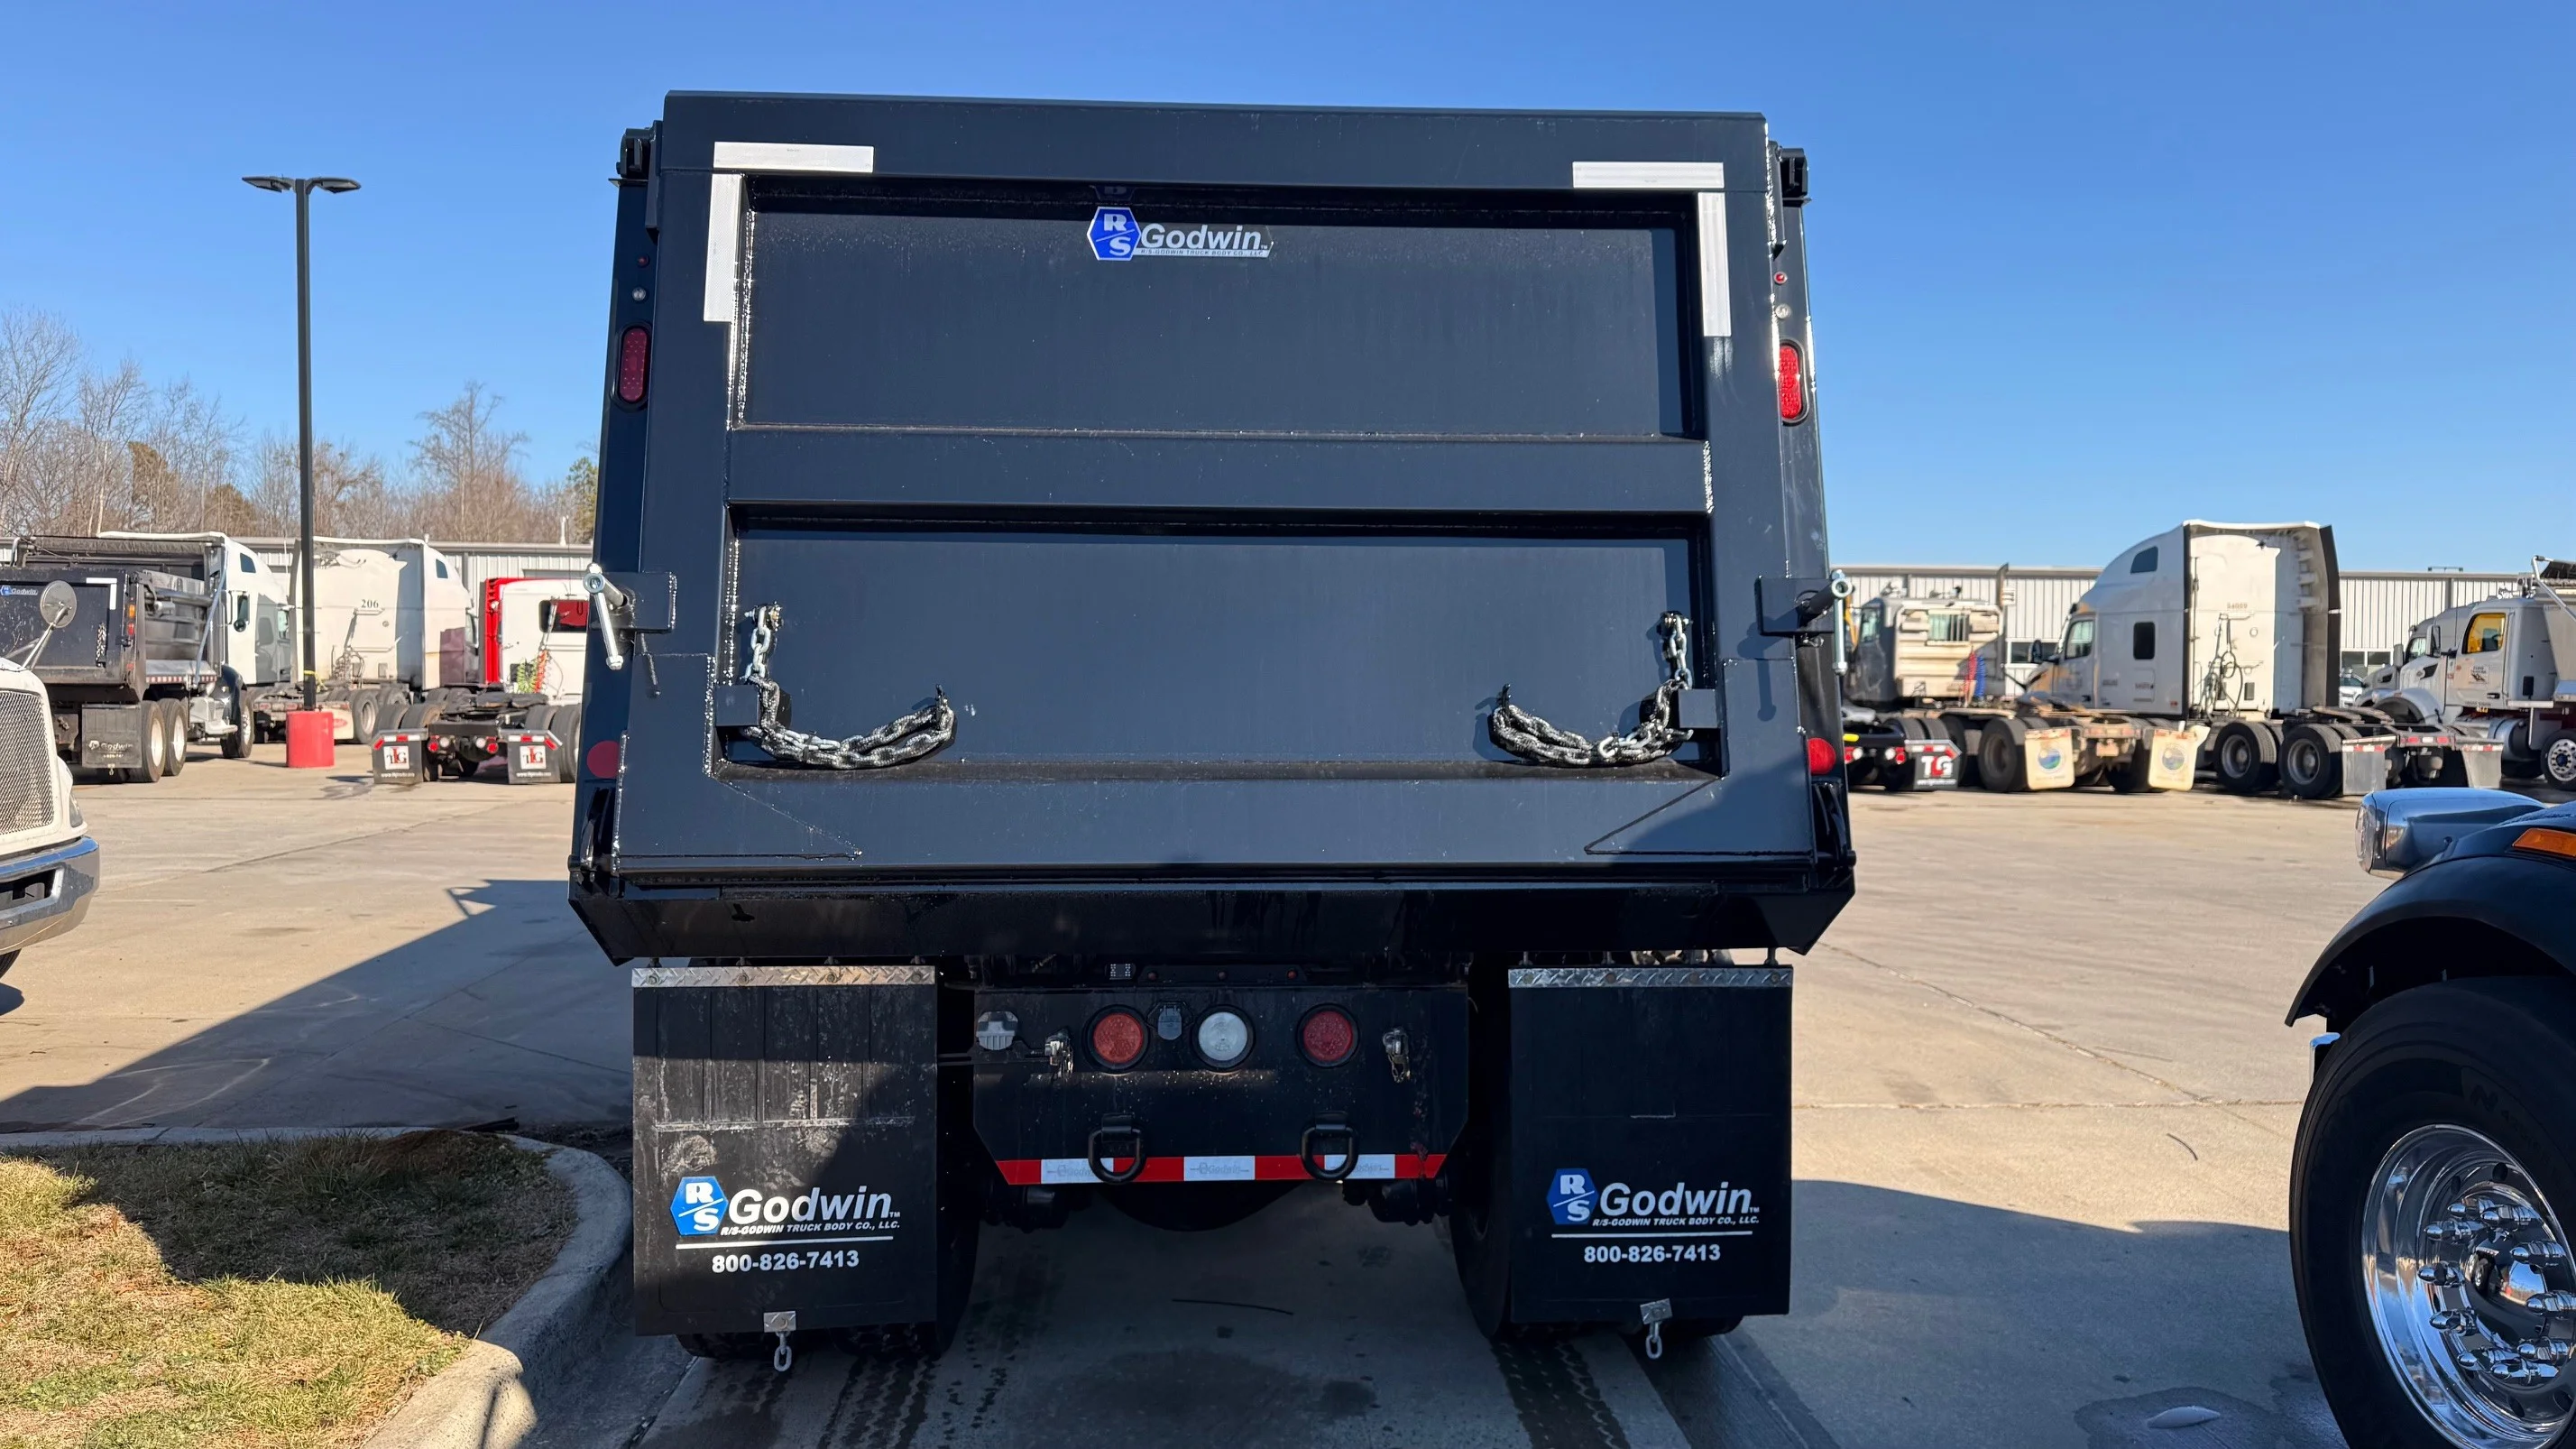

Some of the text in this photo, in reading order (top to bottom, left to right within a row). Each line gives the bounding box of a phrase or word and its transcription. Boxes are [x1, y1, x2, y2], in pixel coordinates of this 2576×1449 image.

[1141, 223, 1261, 250] Godwin
[361, 599, 379, 608] 206
[729, 1186, 891, 1224] Godwin
[1600, 1182, 1752, 1216] Godwin
[721, 1225, 784, 1236] R/S-GODWIN
[787, 1223, 821, 1232] TRUCK
[823, 1222, 852, 1231] BODY
[1592, 1218, 1651, 1226] R/S-GODWIN
[1688, 1217, 1716, 1225] BODY
[712, 1250, 860, 1273] 800-826-7413
[1584, 1244, 1721, 1262] 800-826-7413
